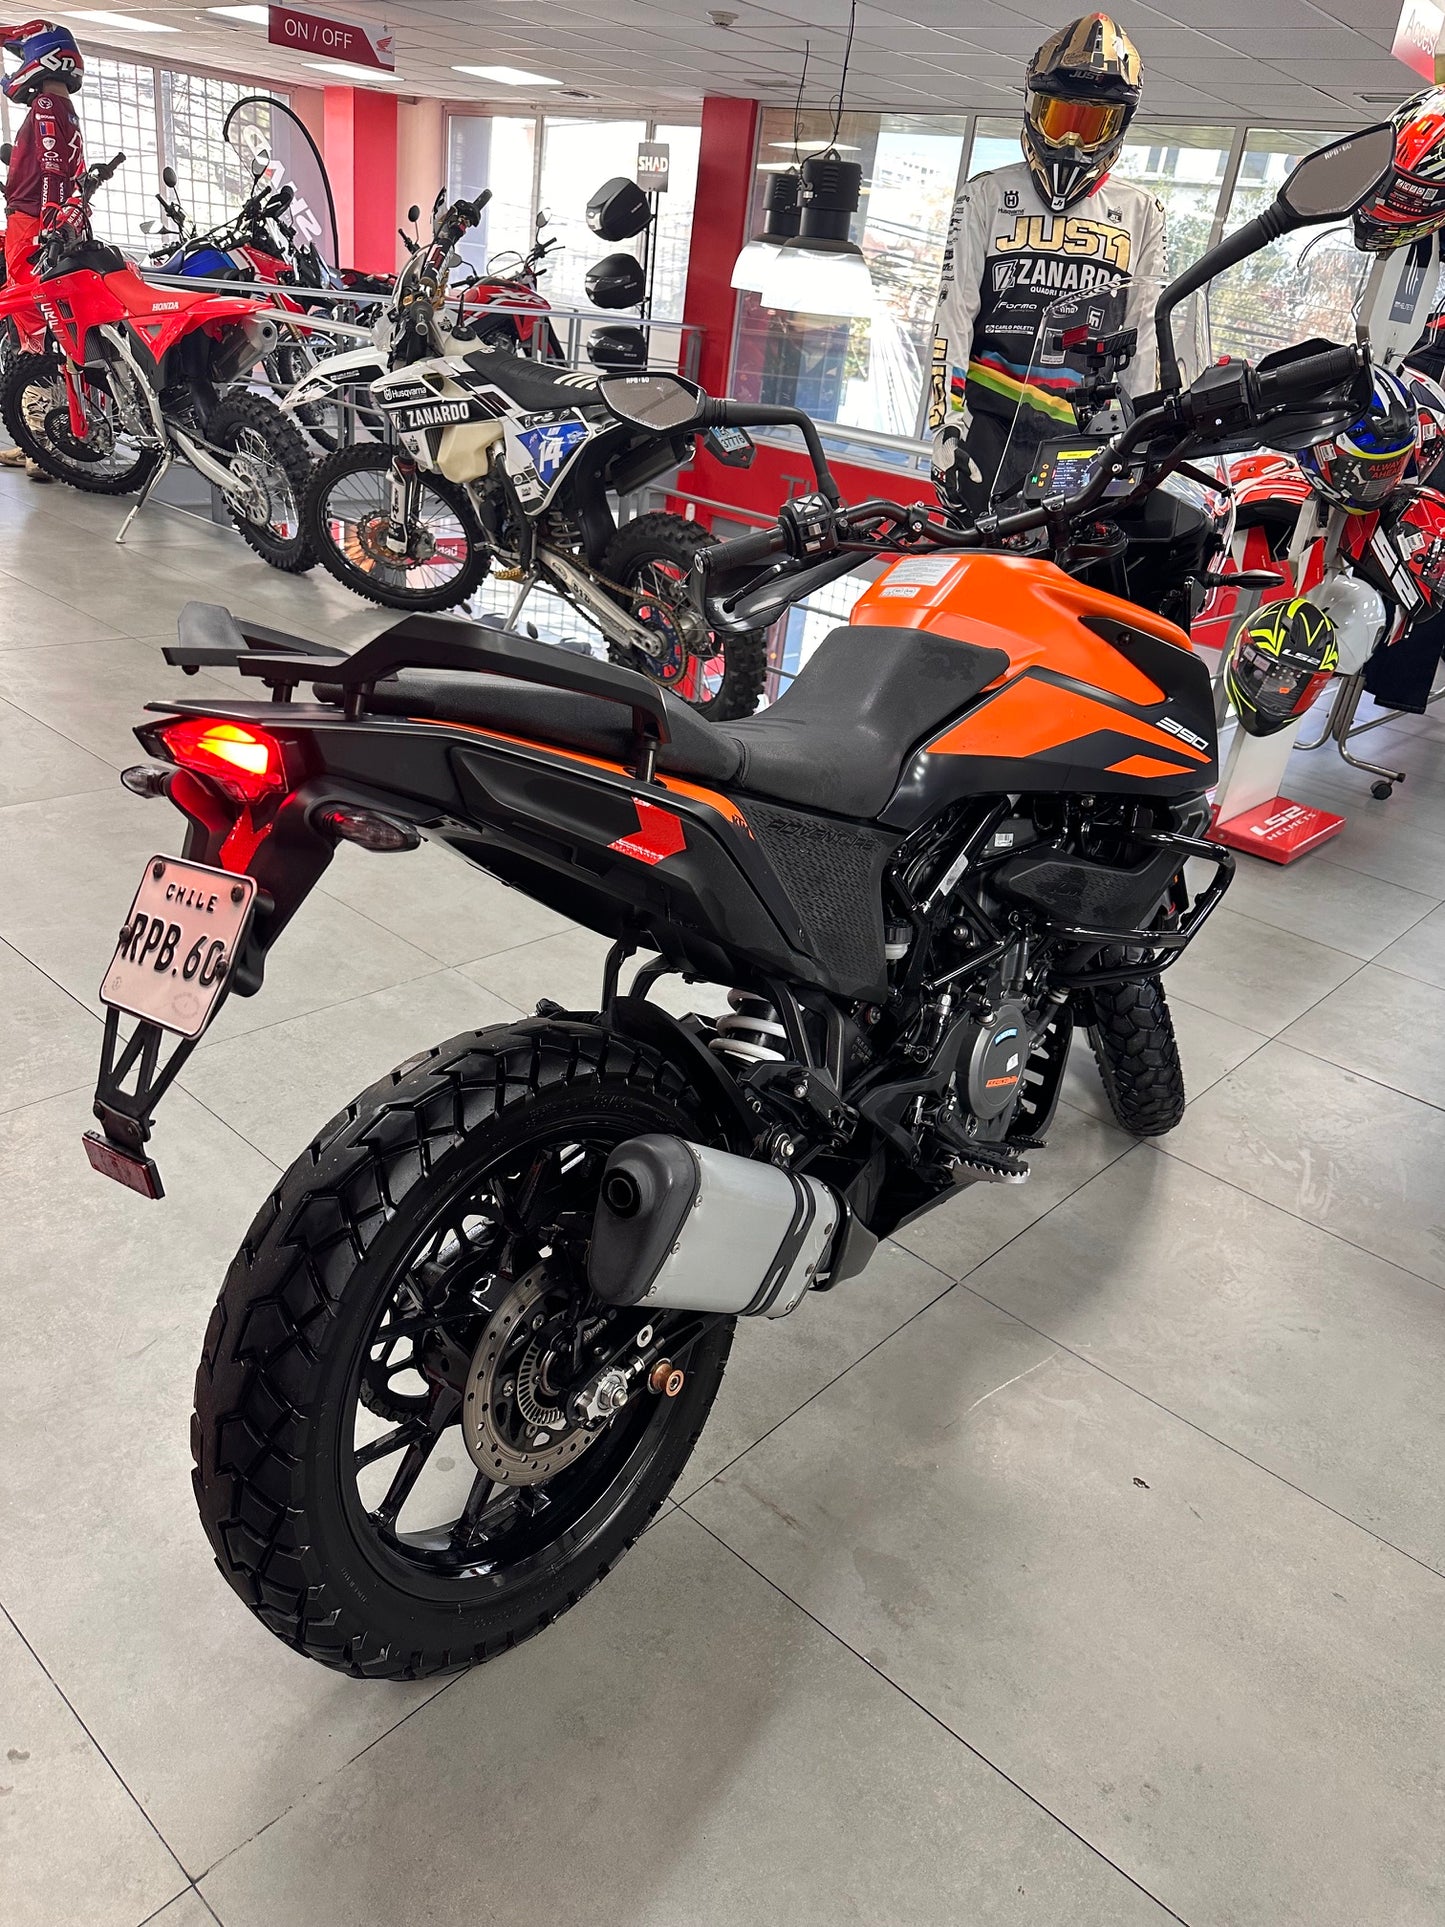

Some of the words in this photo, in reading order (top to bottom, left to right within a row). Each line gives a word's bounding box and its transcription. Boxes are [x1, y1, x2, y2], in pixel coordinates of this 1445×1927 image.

[285, 19, 309, 40] ON
[312, 26, 318, 41] /
[322, 28, 353, 48] OFF
[638, 155, 668, 173] SHAD
[995, 215, 1131, 272] JUST1
[1030, 285, 1057, 296] QUADRI
[152, 301, 179, 312] HONDA
[391, 386, 427, 399] Husqvarna
[406, 402, 470, 428] ZANARDO
[539, 436, 563, 473] 14
[1282, 648, 1320, 666] LS2
[1155, 716, 1209, 751] 390
[1249, 805, 1306, 836] LS2
[1266, 812, 1317, 840] HELMETS
[166, 883, 219, 913] CHILE
